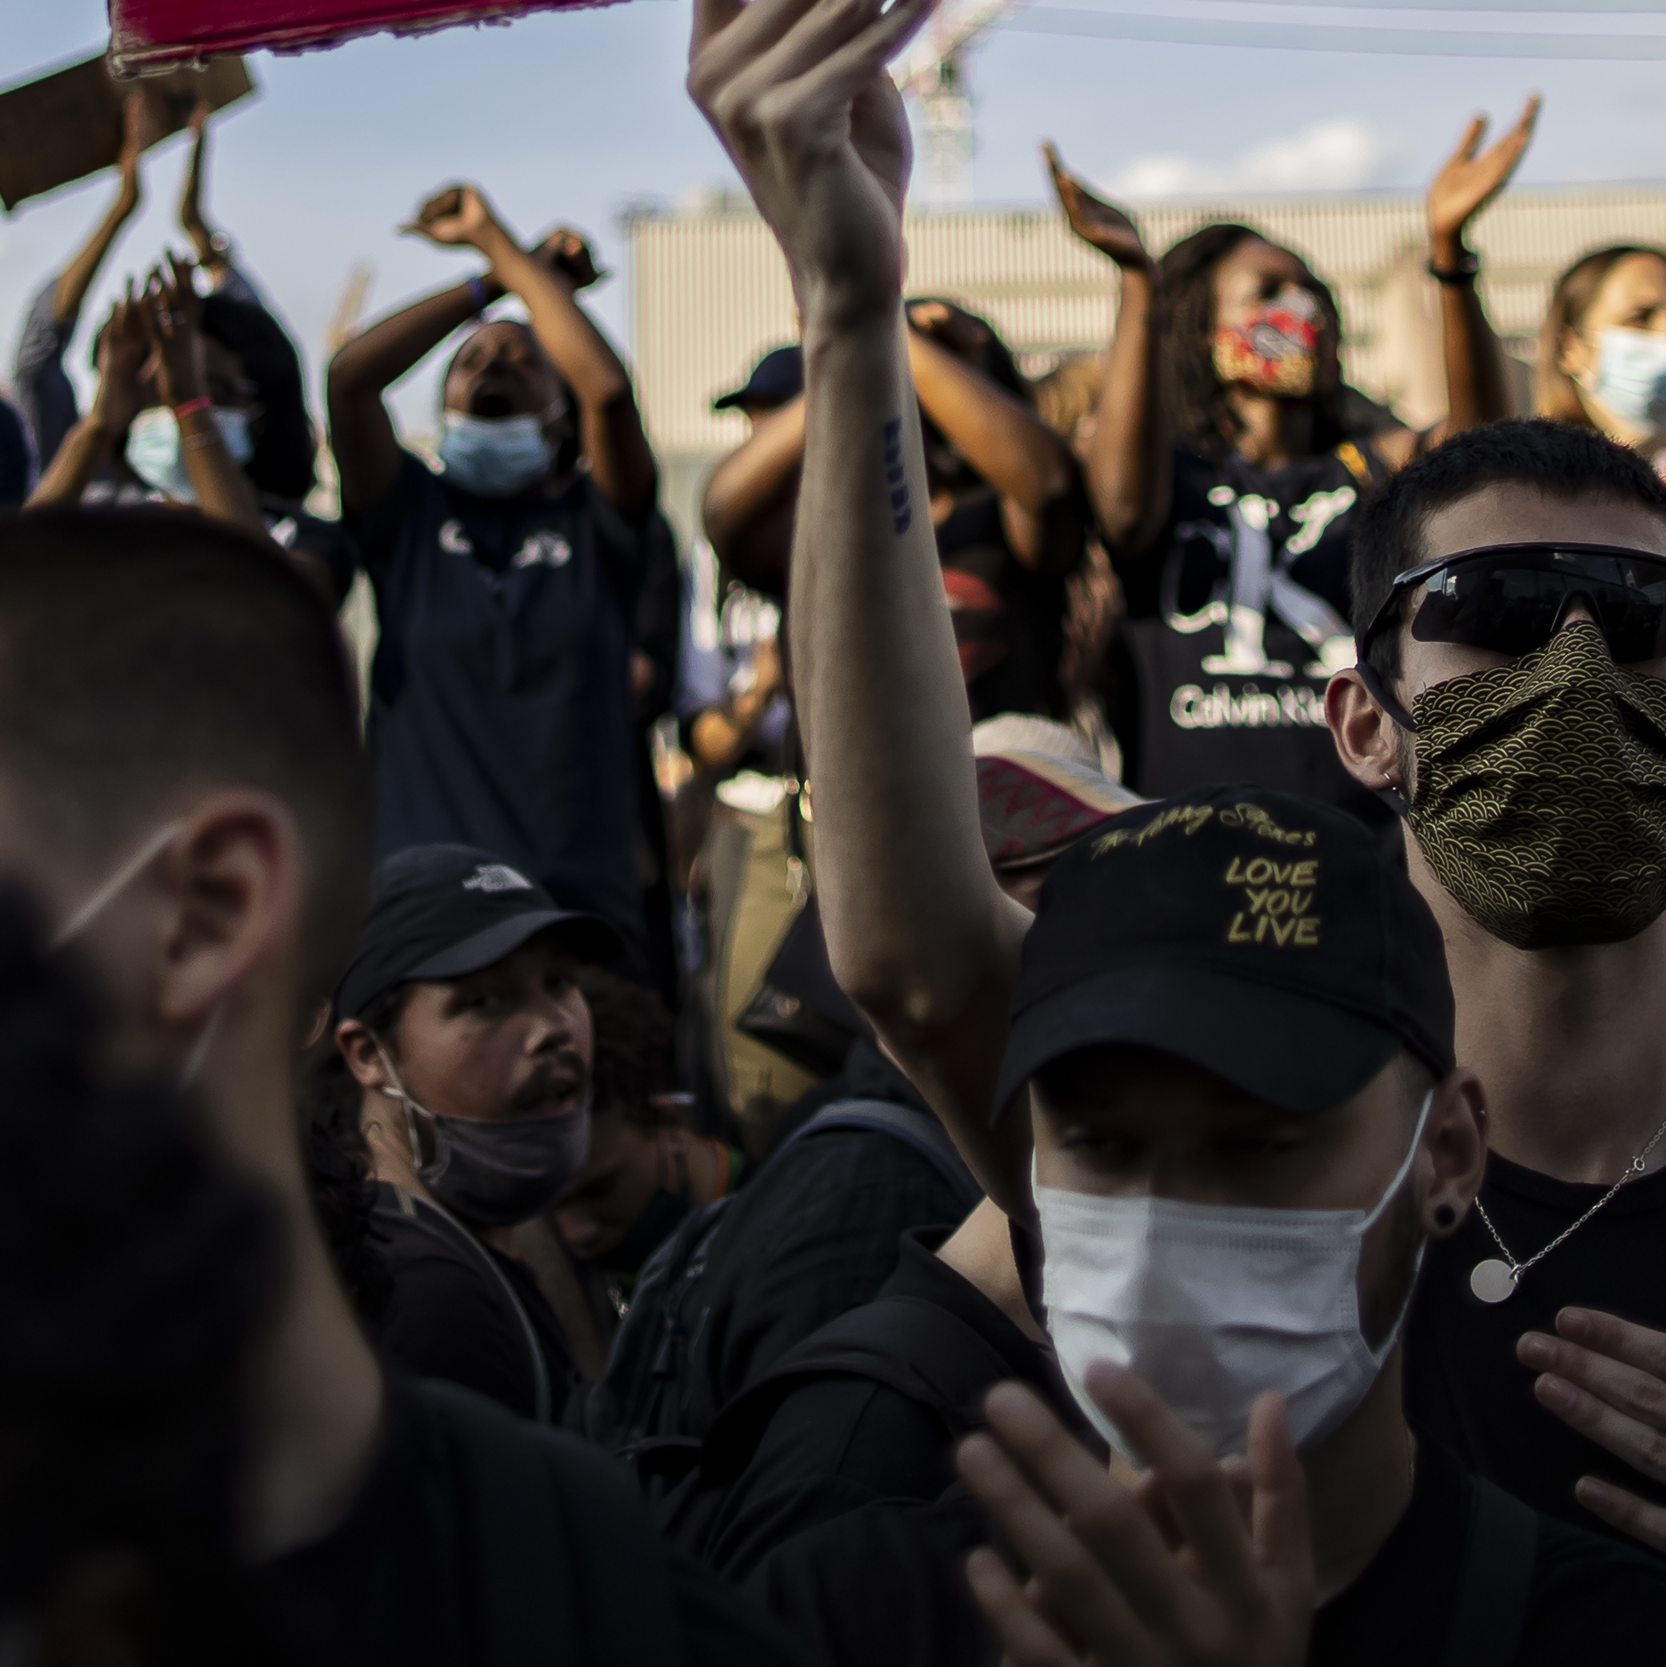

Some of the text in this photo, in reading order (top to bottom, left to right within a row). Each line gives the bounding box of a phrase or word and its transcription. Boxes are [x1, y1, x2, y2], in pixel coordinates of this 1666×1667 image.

[1225, 856, 1320, 886] LOVE
[1245, 887, 1313, 915] YOU
[1228, 911, 1322, 947] LIVE
